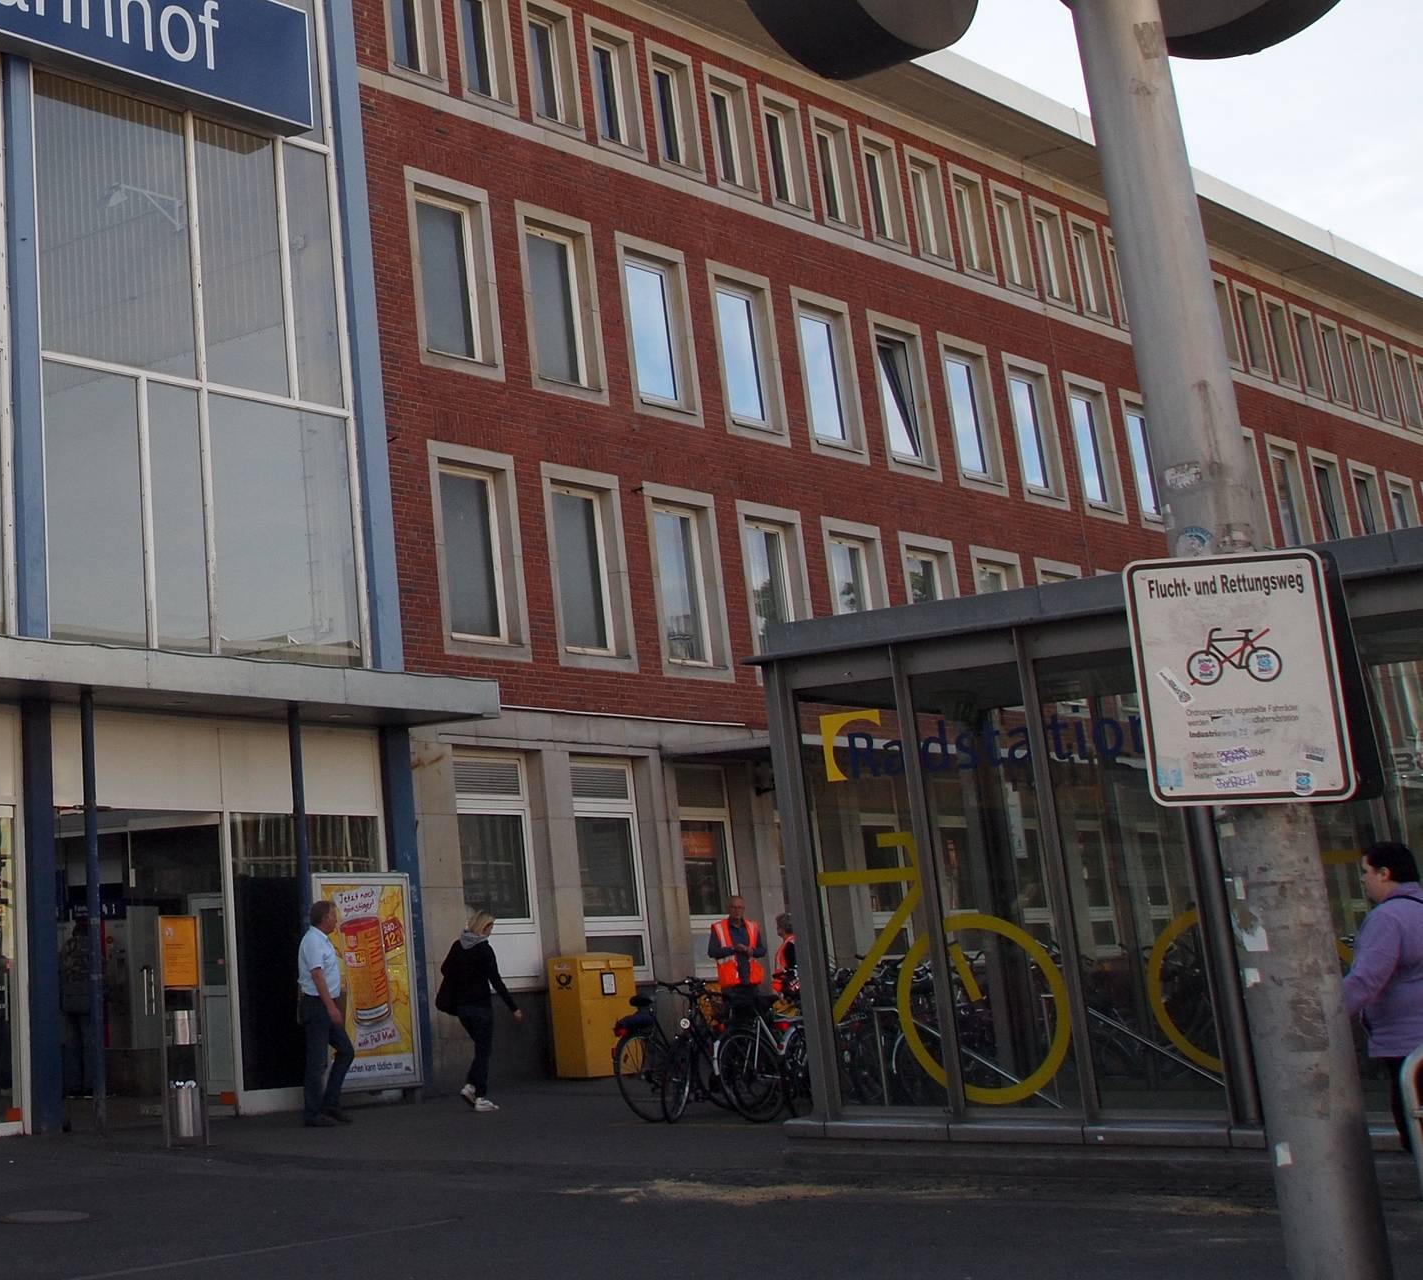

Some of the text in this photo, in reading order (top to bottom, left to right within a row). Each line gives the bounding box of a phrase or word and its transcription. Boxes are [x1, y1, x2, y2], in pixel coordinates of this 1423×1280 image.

[1147, 573, 1305, 599] Flucht- und Rettungsweg
